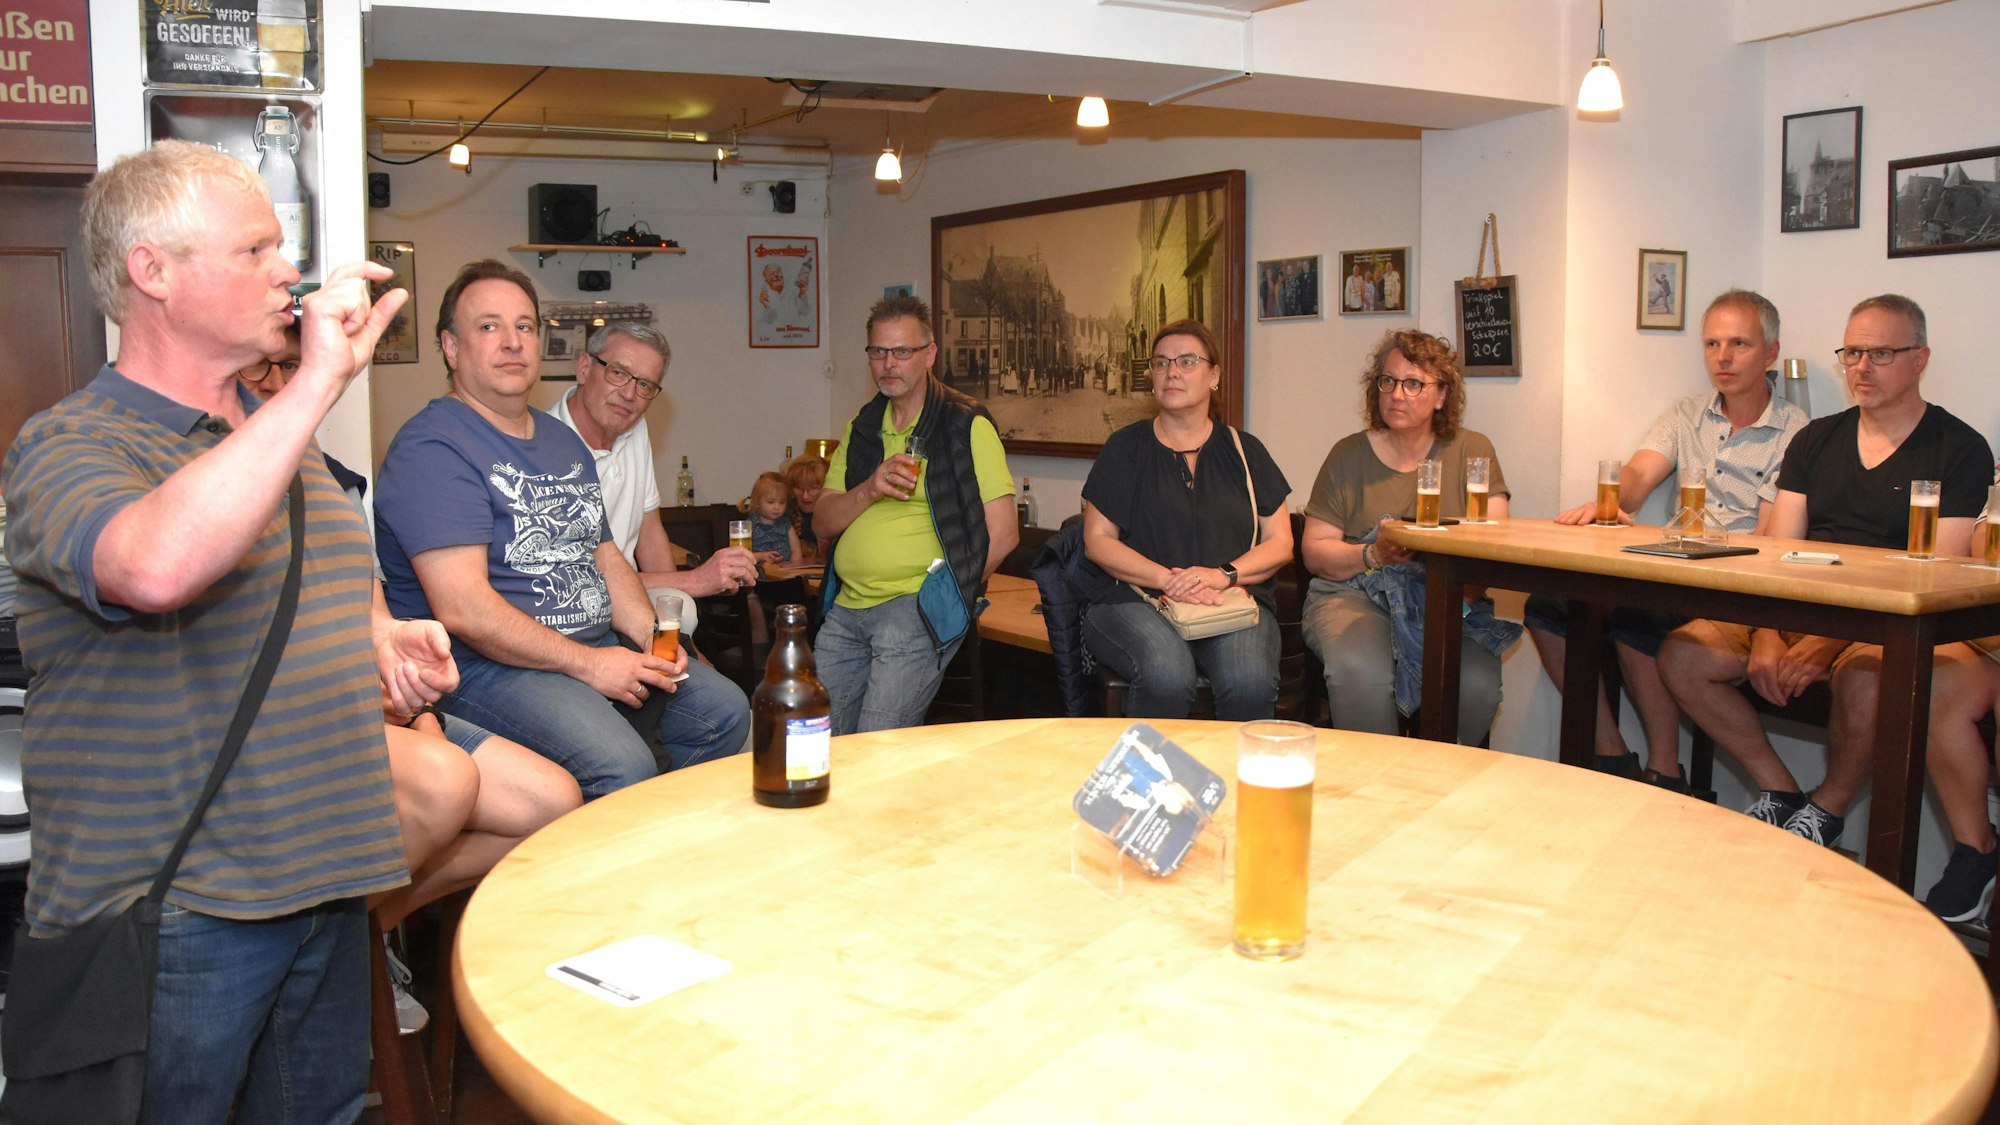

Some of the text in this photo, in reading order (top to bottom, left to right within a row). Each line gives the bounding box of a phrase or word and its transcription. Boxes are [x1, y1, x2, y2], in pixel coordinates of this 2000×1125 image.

[215, 8, 251, 22] WIRD
[0, 11, 75, 41] ßen
[156, 22, 251, 47] GESOFFEN!
[184, 53, 210, 62] DANKE
[173, 62, 187, 70] IHR
[375, 245, 402, 263] RIP
[1463, 290, 1503, 305] Trinkspiel
[1465, 305, 1495, 319] mit 10
[1472, 342, 1502, 358] 20€
[534, 611, 587, 627] ESTABLISHED
